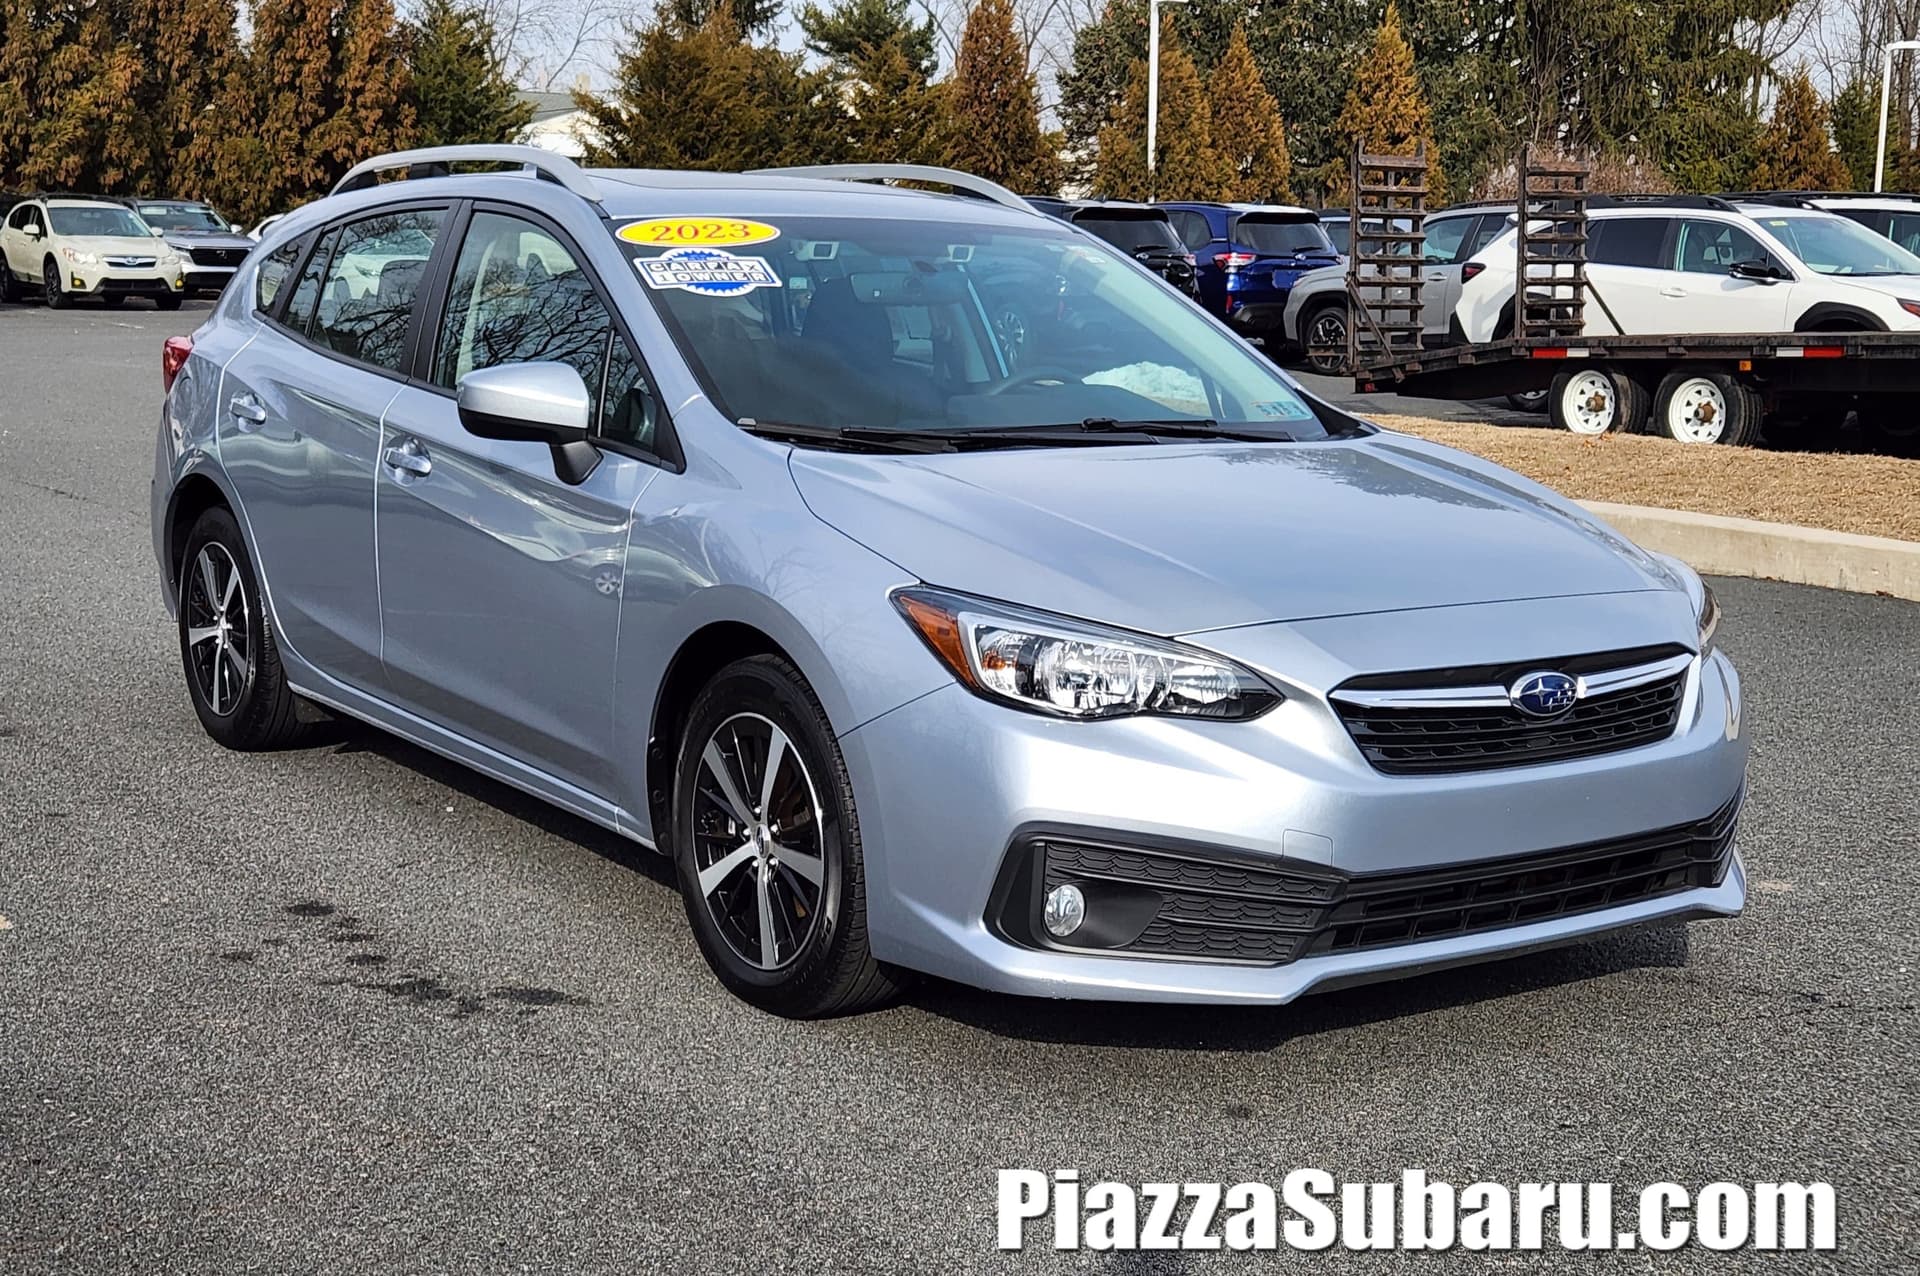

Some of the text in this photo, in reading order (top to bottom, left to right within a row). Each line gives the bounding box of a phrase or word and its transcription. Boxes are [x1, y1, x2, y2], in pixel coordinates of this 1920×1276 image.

[651, 223, 751, 241] 2023
[648, 261, 759, 272] CARFAX
[674, 271, 767, 282] OWNER
